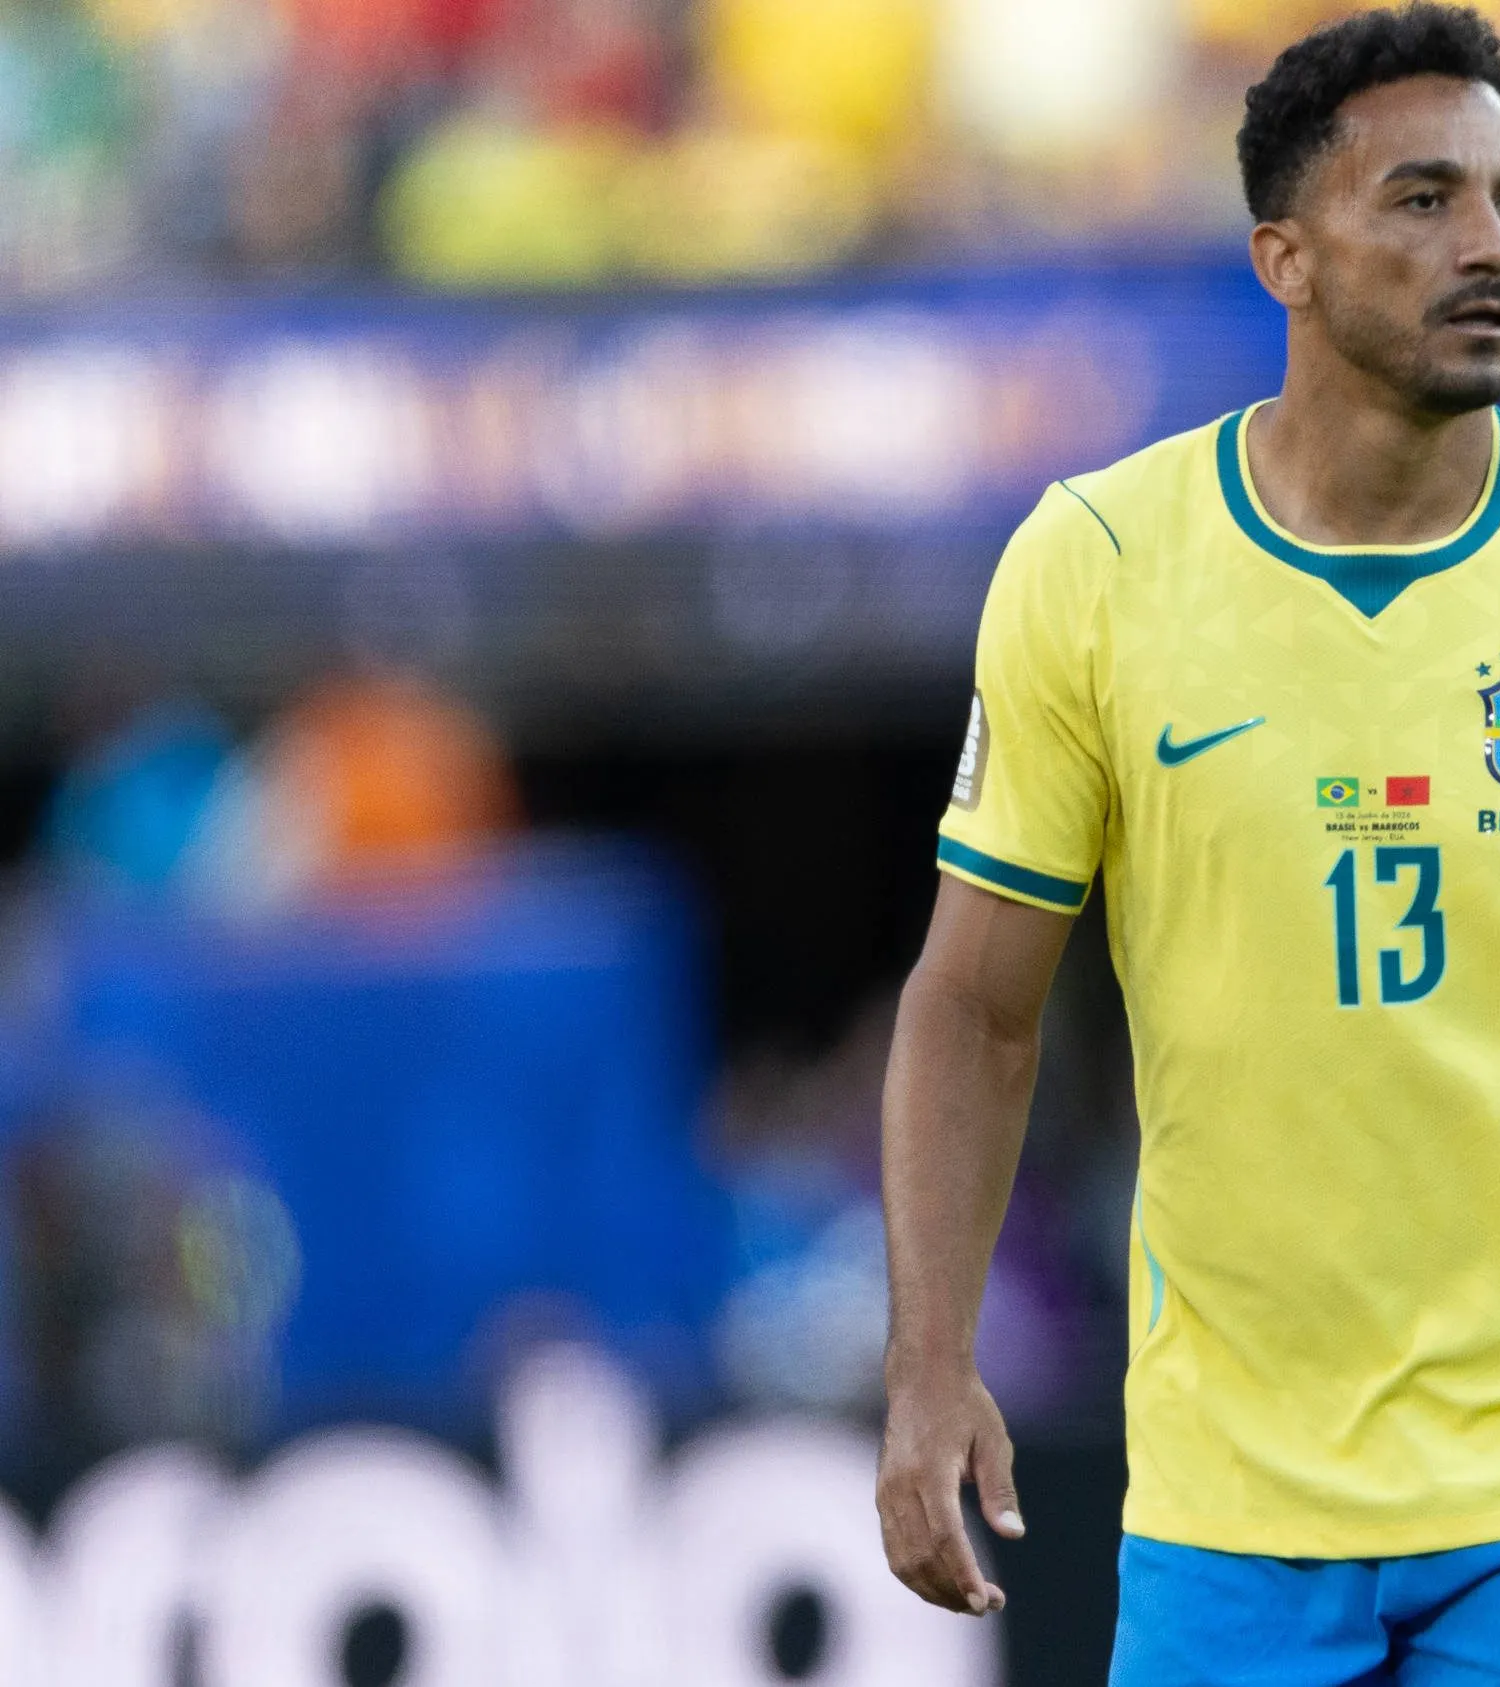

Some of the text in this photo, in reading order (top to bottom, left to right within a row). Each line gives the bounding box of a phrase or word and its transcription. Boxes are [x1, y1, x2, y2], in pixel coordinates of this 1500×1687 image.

[1326, 823, 1356, 832] BRASIL
[1372, 822, 1420, 831] MARROCOS
[1361, 834, 1383, 842] Jersey
[1389, 833, 1405, 841] EUA
[1323, 844, 1446, 1010] 13
